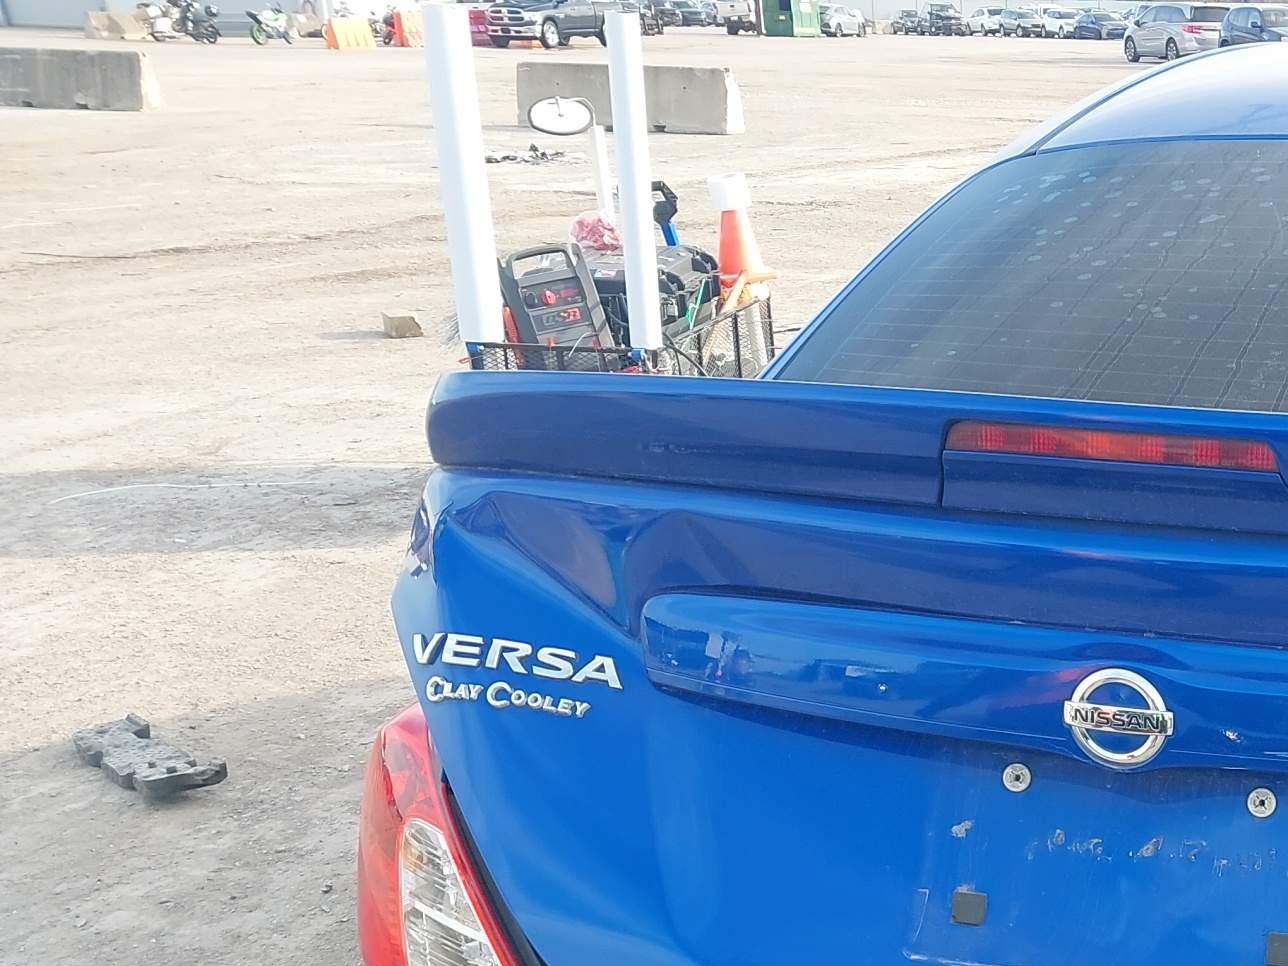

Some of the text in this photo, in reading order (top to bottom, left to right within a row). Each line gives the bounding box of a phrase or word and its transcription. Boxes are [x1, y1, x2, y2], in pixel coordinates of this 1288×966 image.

[413, 632, 623, 689] VERSA
[426, 676, 591, 717] CLAY COOLEY
[1074, 708, 1160, 729] NISSAN
